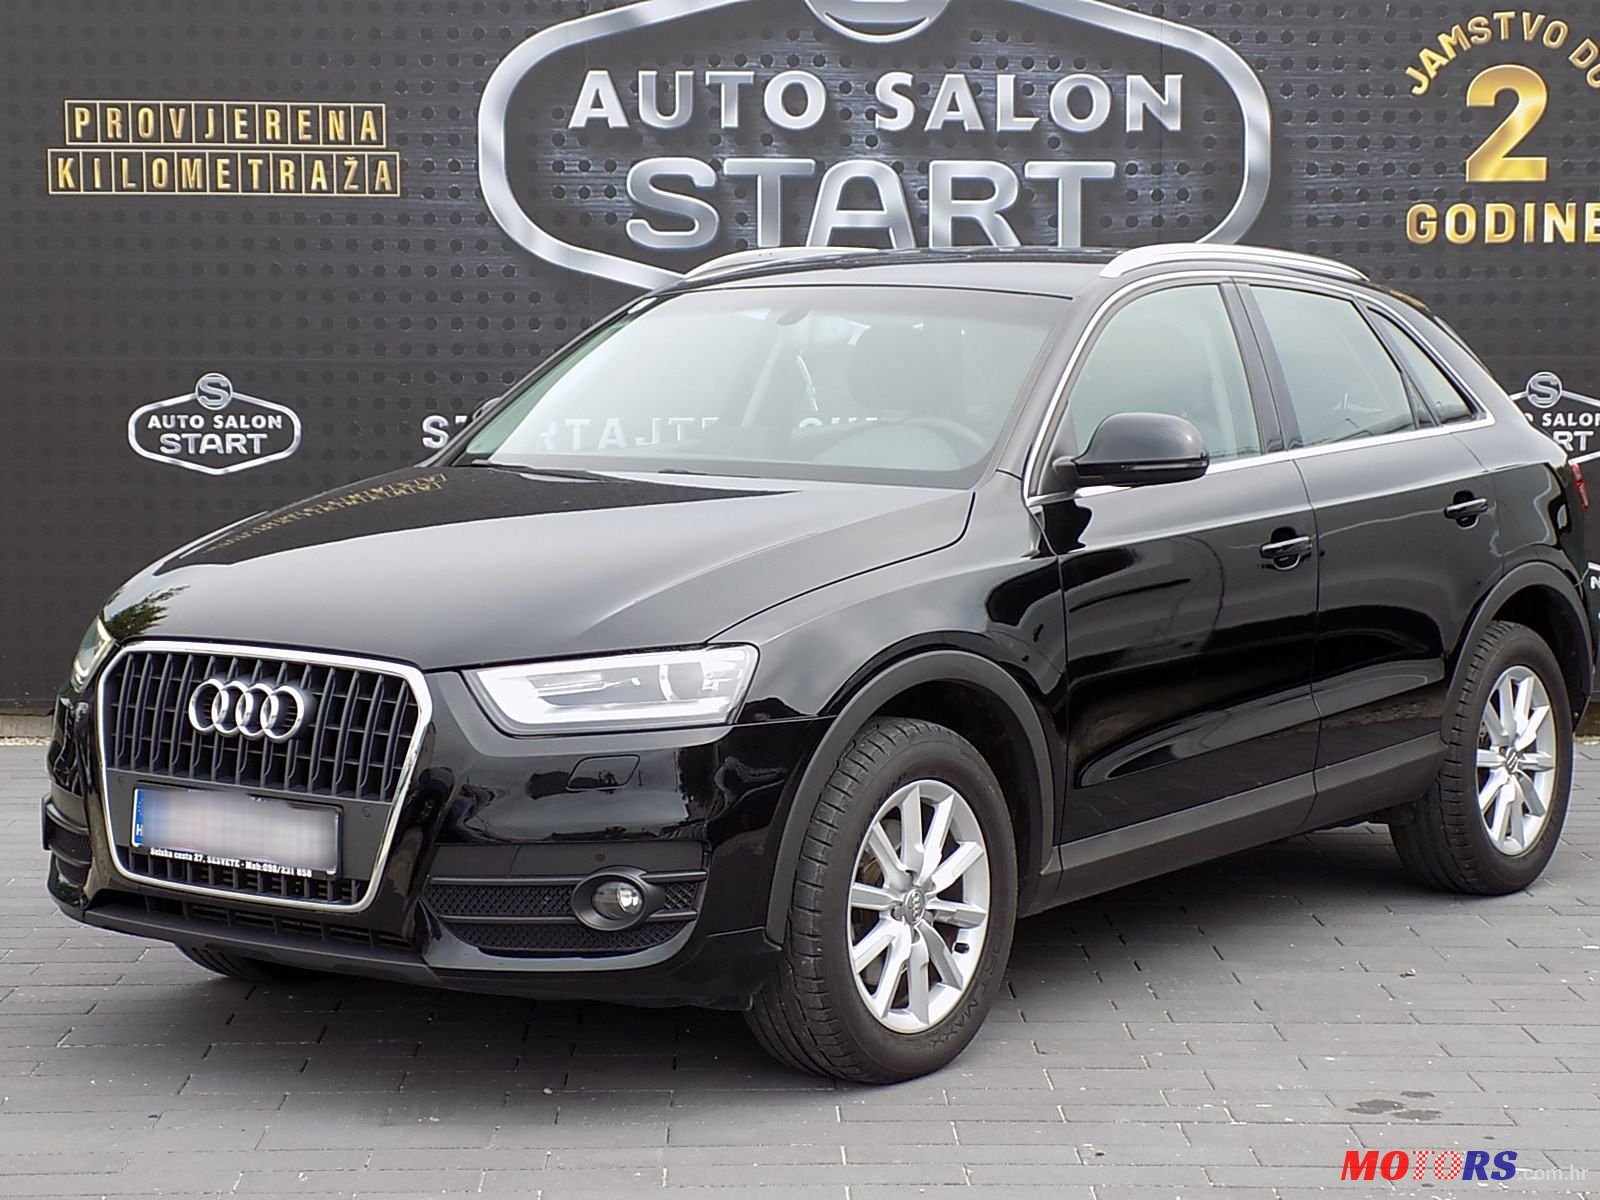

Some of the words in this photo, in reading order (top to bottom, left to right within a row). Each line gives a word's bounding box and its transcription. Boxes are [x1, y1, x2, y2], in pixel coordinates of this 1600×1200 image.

[1405, 10, 1569, 96] JAMSTVO
[568, 70, 827, 129] AUTO
[874, 72, 1183, 132] SALON
[74, 107, 378, 141] PROVJERENA
[1465, 63, 1549, 183] 2
[57, 156, 393, 190] KILOMETRAŽA
[624, 156, 1117, 250] START
[1406, 203, 1600, 244] GODINE
[147, 415, 204, 430] AUTO
[213, 415, 282, 430] SALON
[160, 433, 267, 454] START
